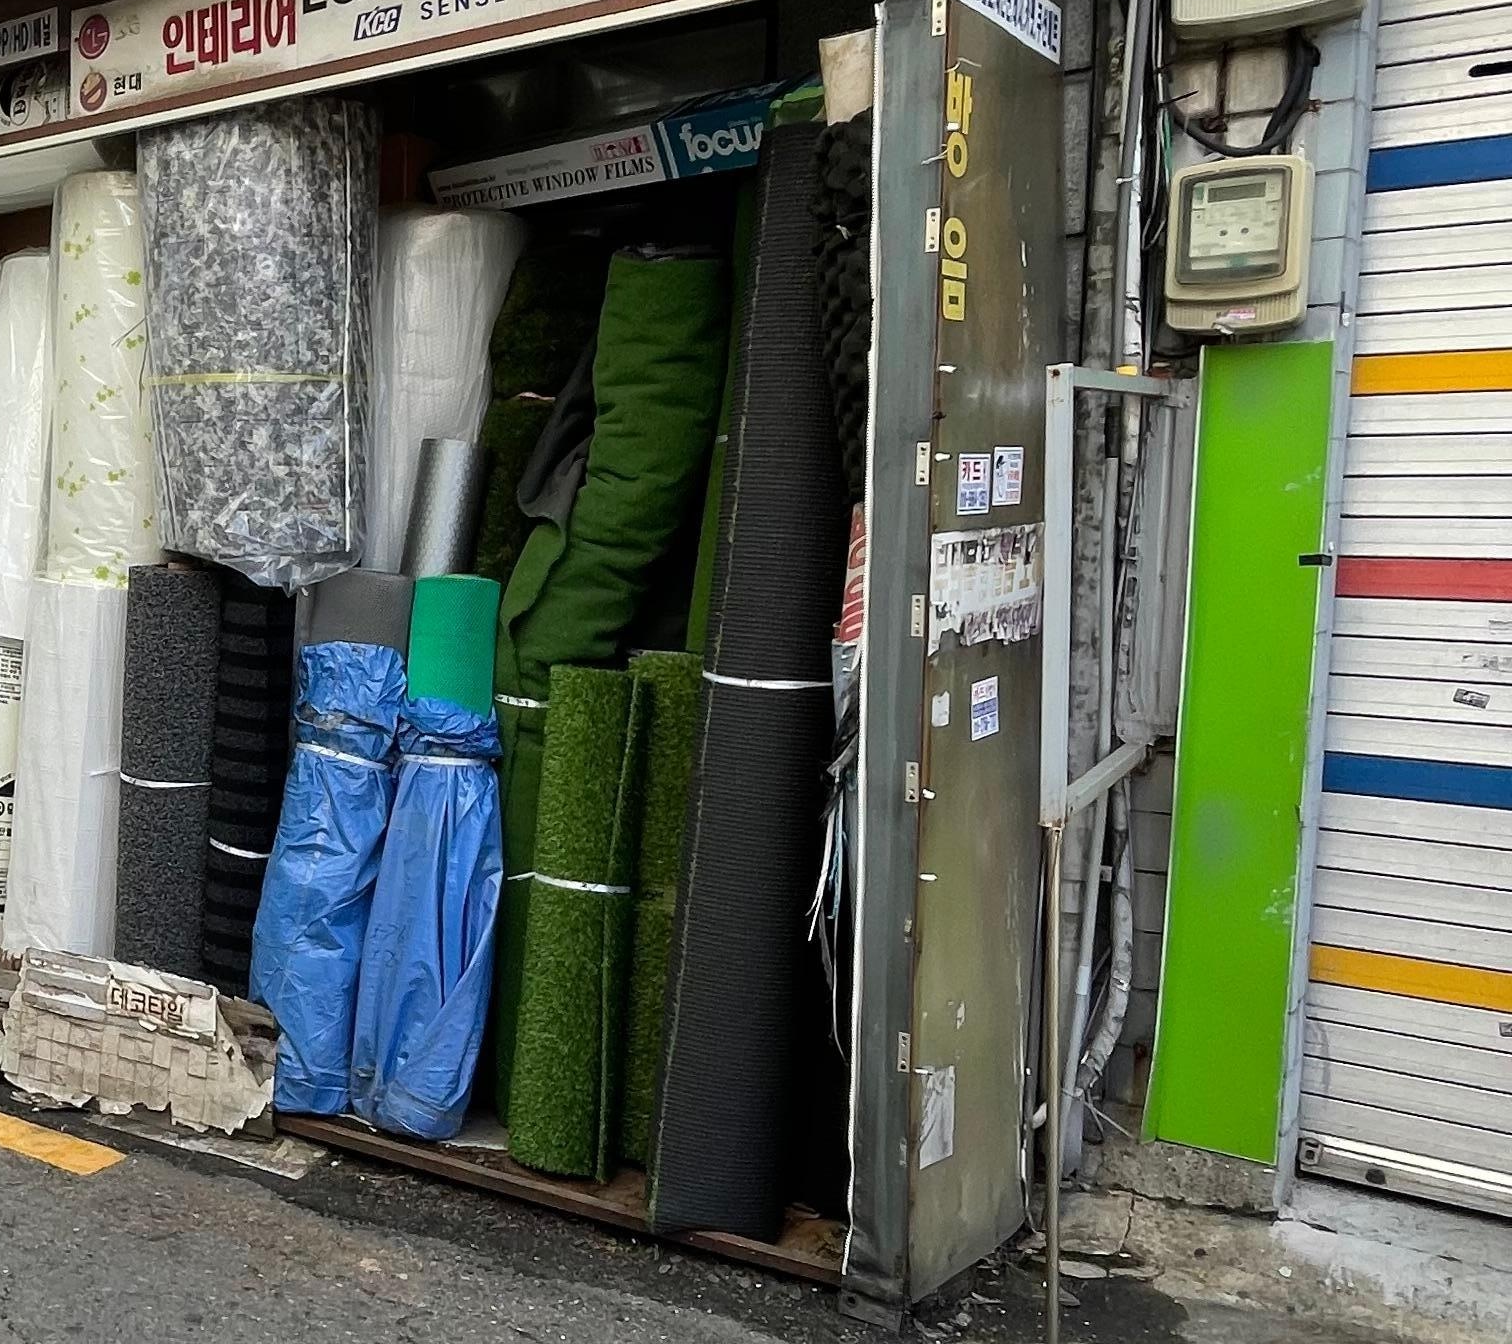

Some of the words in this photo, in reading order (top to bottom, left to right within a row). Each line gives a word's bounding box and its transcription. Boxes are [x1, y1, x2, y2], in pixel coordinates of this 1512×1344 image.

[356, 5, 398, 40] KCC
[113, 72, 143, 96] 현대
[532, 165, 599, 192] WINDOW
[603, 155, 655, 181] FILMS
[110, 986, 185, 1025] 데코타일
